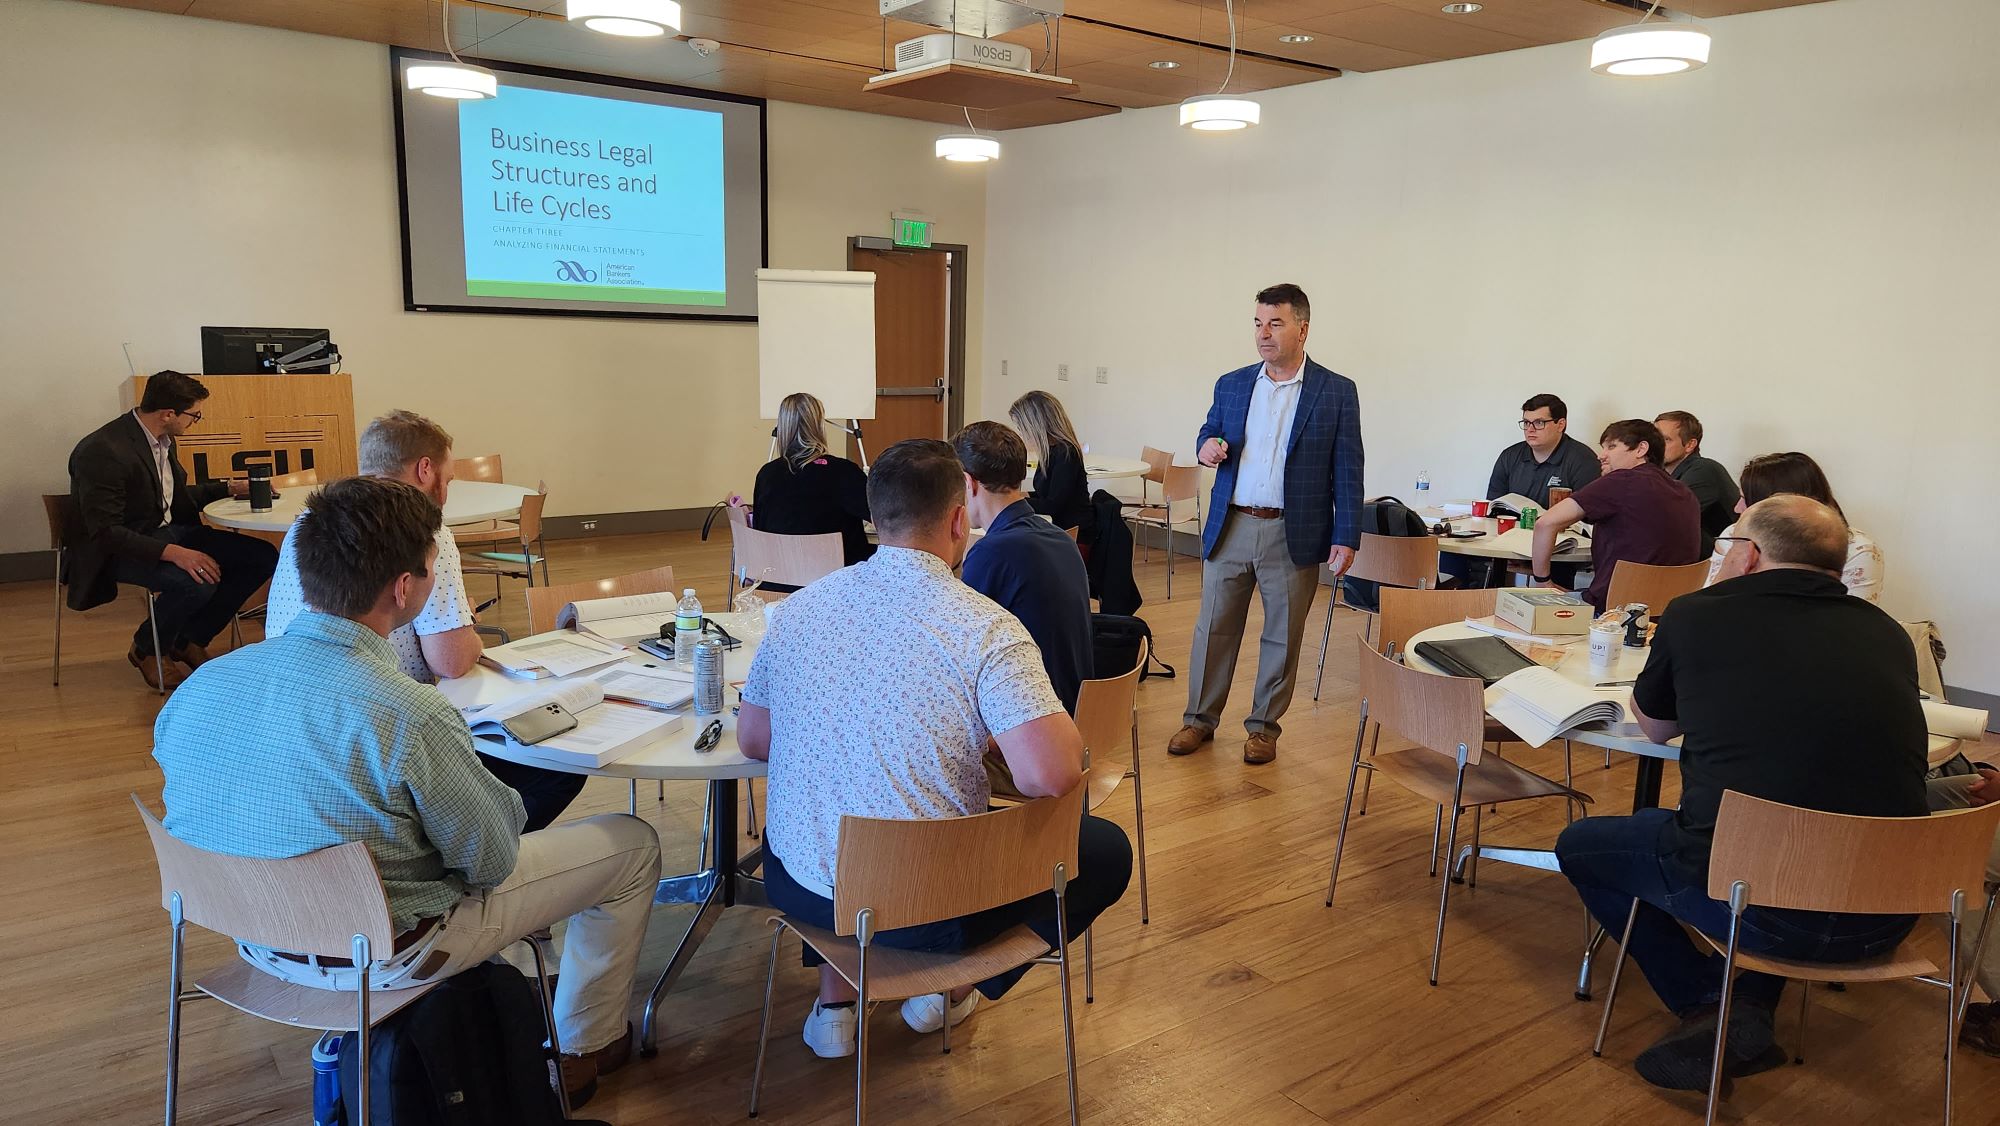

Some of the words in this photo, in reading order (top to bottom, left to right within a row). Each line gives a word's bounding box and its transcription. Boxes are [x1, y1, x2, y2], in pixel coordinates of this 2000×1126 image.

[973, 44, 1012, 62] EPSON
[491, 127, 591, 158] Business
[598, 139, 653, 167] Legal
[491, 159, 610, 190] Structures
[617, 174, 657, 195] and
[493, 190, 534, 214] Life
[541, 195, 611, 221] Cycles
[492, 225, 534, 235] CHAPTER
[536, 227, 564, 237] THREE
[903, 220, 927, 244] EXIT
[493, 239, 543, 249] ANALYZING
[546, 242, 590, 253] FINANCIAL
[593, 246, 645, 256] STATEMENTS
[606, 262, 636, 271] American
[606, 270, 631, 278] Bankers
[192, 448, 315, 485] LSU
